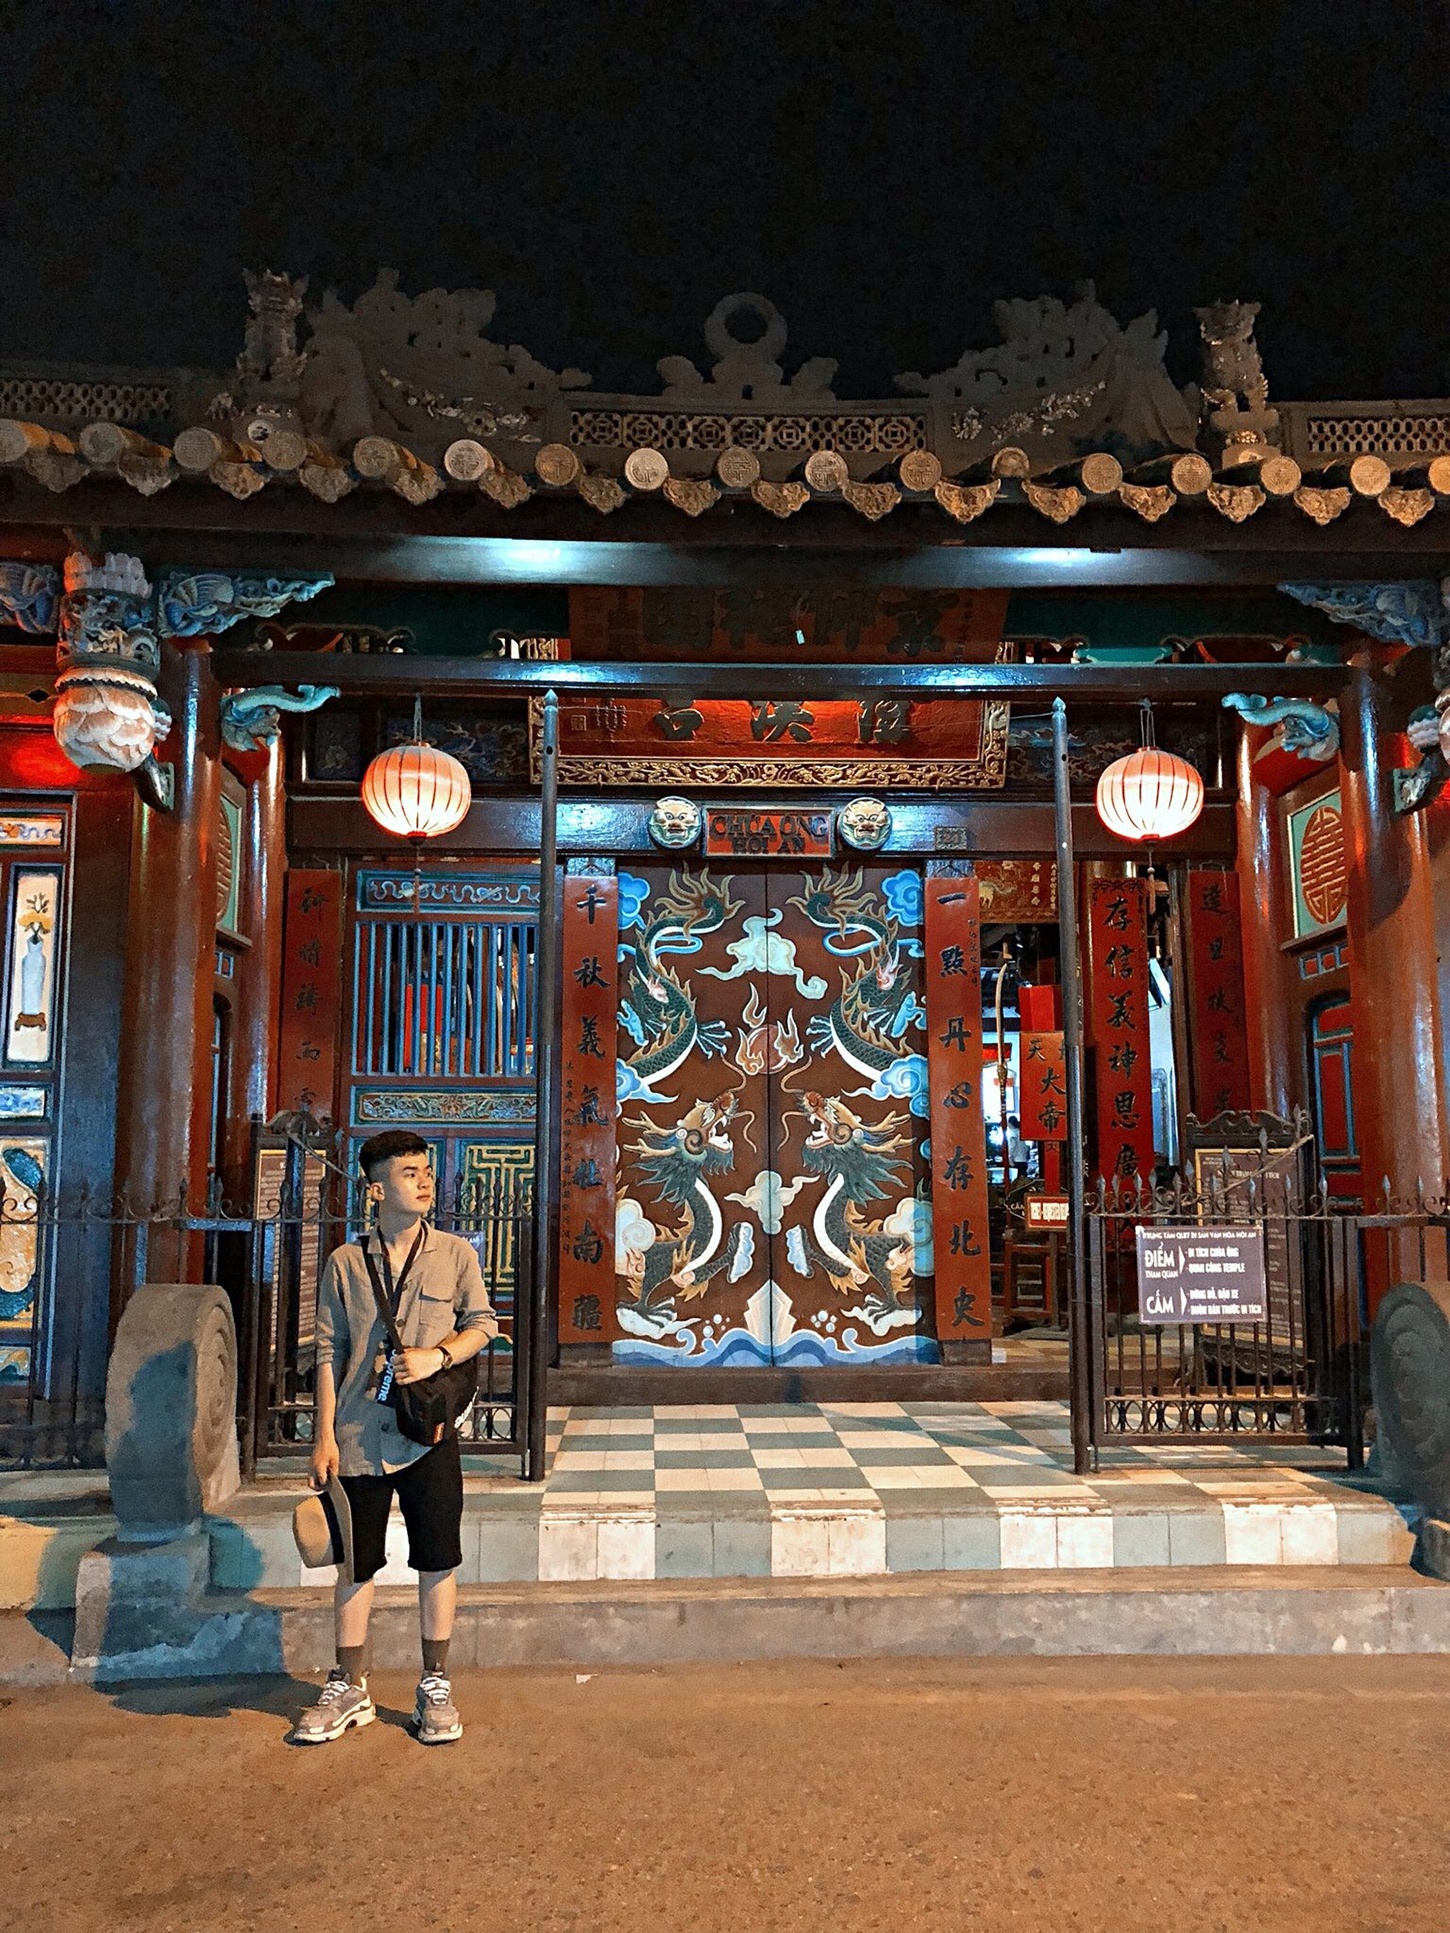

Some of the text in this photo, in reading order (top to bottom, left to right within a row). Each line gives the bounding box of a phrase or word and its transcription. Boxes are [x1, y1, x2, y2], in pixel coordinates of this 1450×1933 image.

[1144, 1241, 1175, 1268] ĐIỂM
[1222, 1263, 1246, 1273] TEMPLE
[1145, 1270, 1179, 1279] THAM QUAN
[1231, 1289, 1239, 1299] XE
[1146, 1289, 1175, 1315] CẤM
